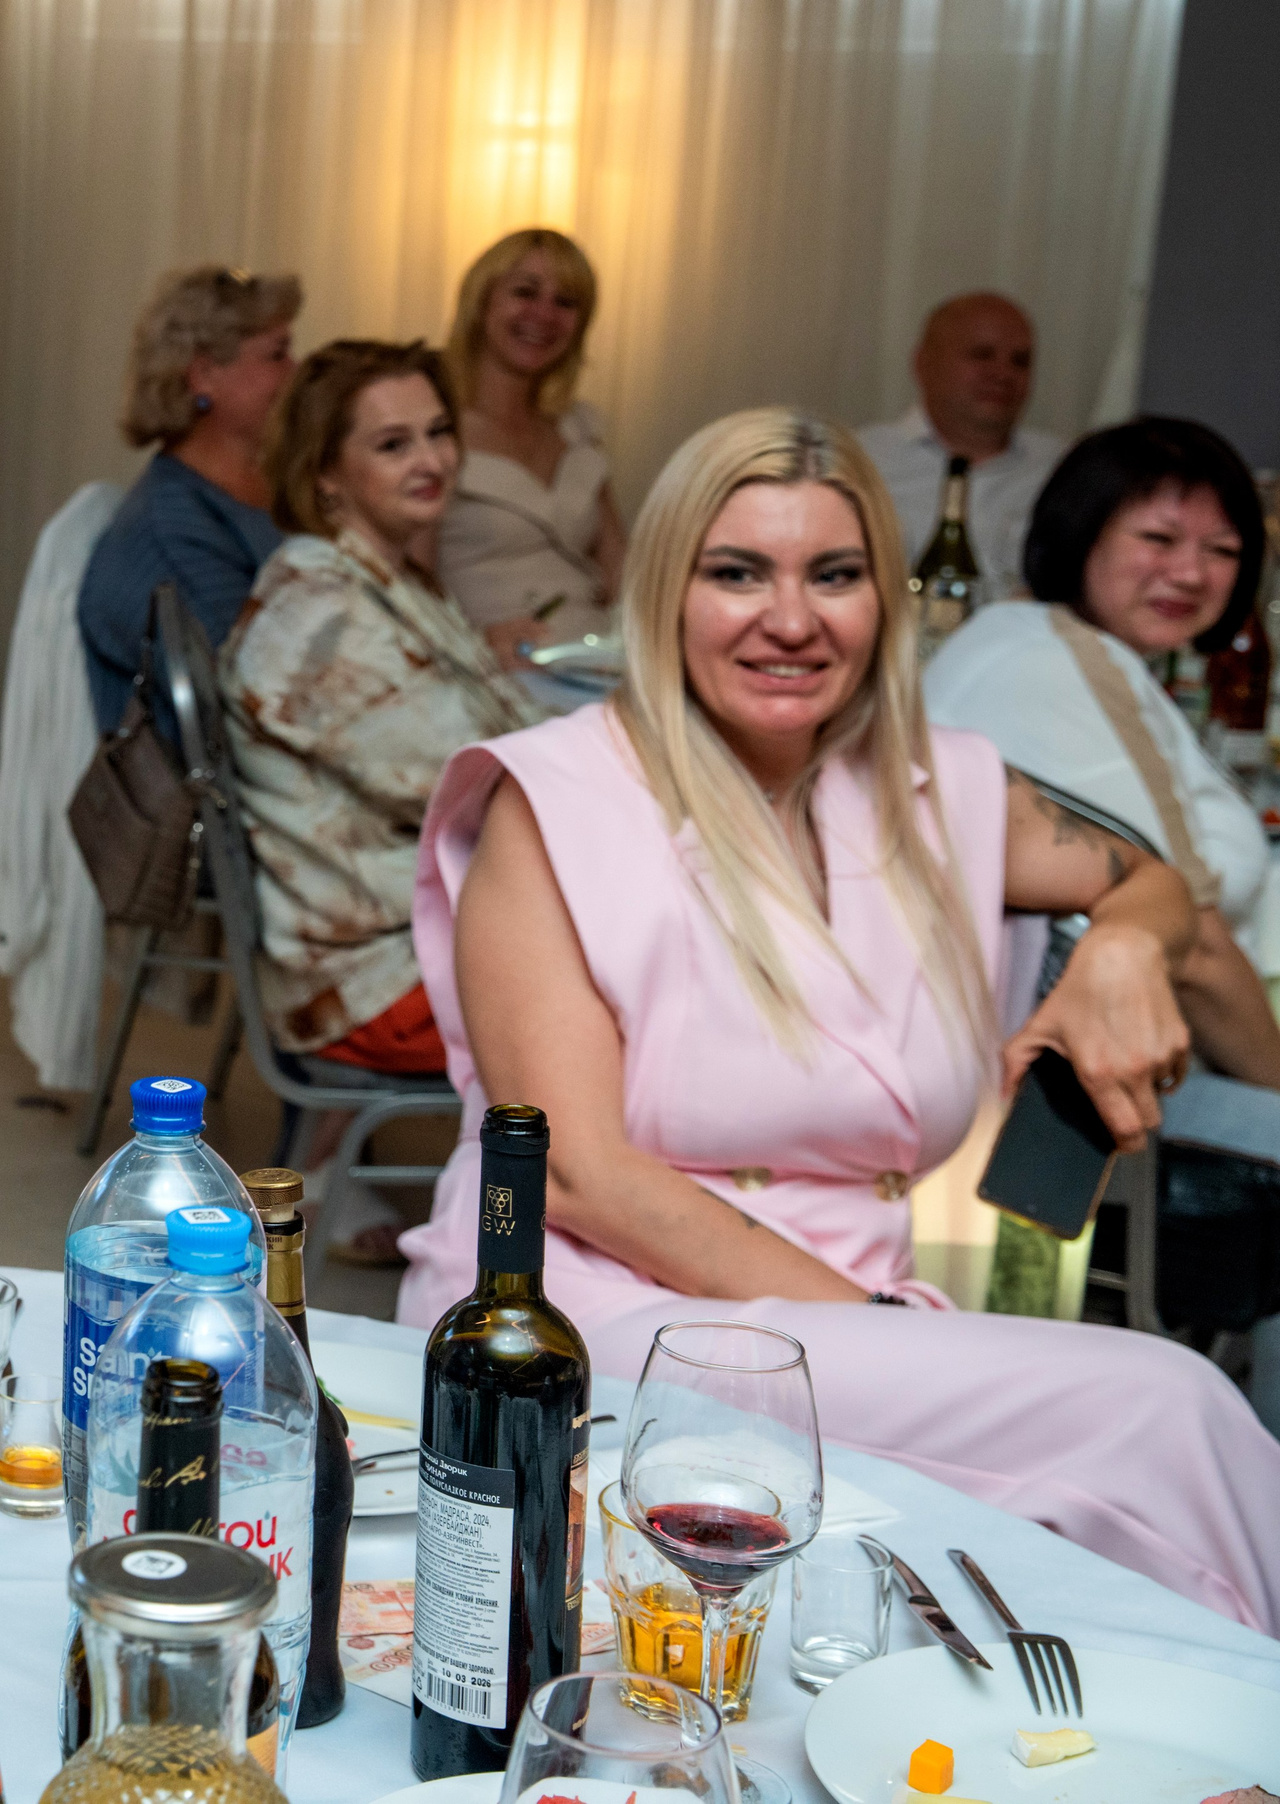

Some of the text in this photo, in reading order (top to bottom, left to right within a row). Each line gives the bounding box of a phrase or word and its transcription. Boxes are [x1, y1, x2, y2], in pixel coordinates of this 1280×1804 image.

[424, 1461, 447, 1480] ЧИНАР
[439, 1459, 468, 1476] Дворик
[429, 1475, 501, 1504] ПОЛУСЛАДКОЕ КРАСНОЕ
[432, 1511, 484, 1539] (АЗЕРБАЙДЖАН).
[440, 1503, 471, 1524] МАДРАСА,
[473, 1513, 492, 1529] 2024,
[450, 1658, 468, 1670] ВАШЕМУ
[469, 1664, 495, 1675] ЗДОРОВЬЮ.
[442, 1667, 491, 1688] 10 03 2026
